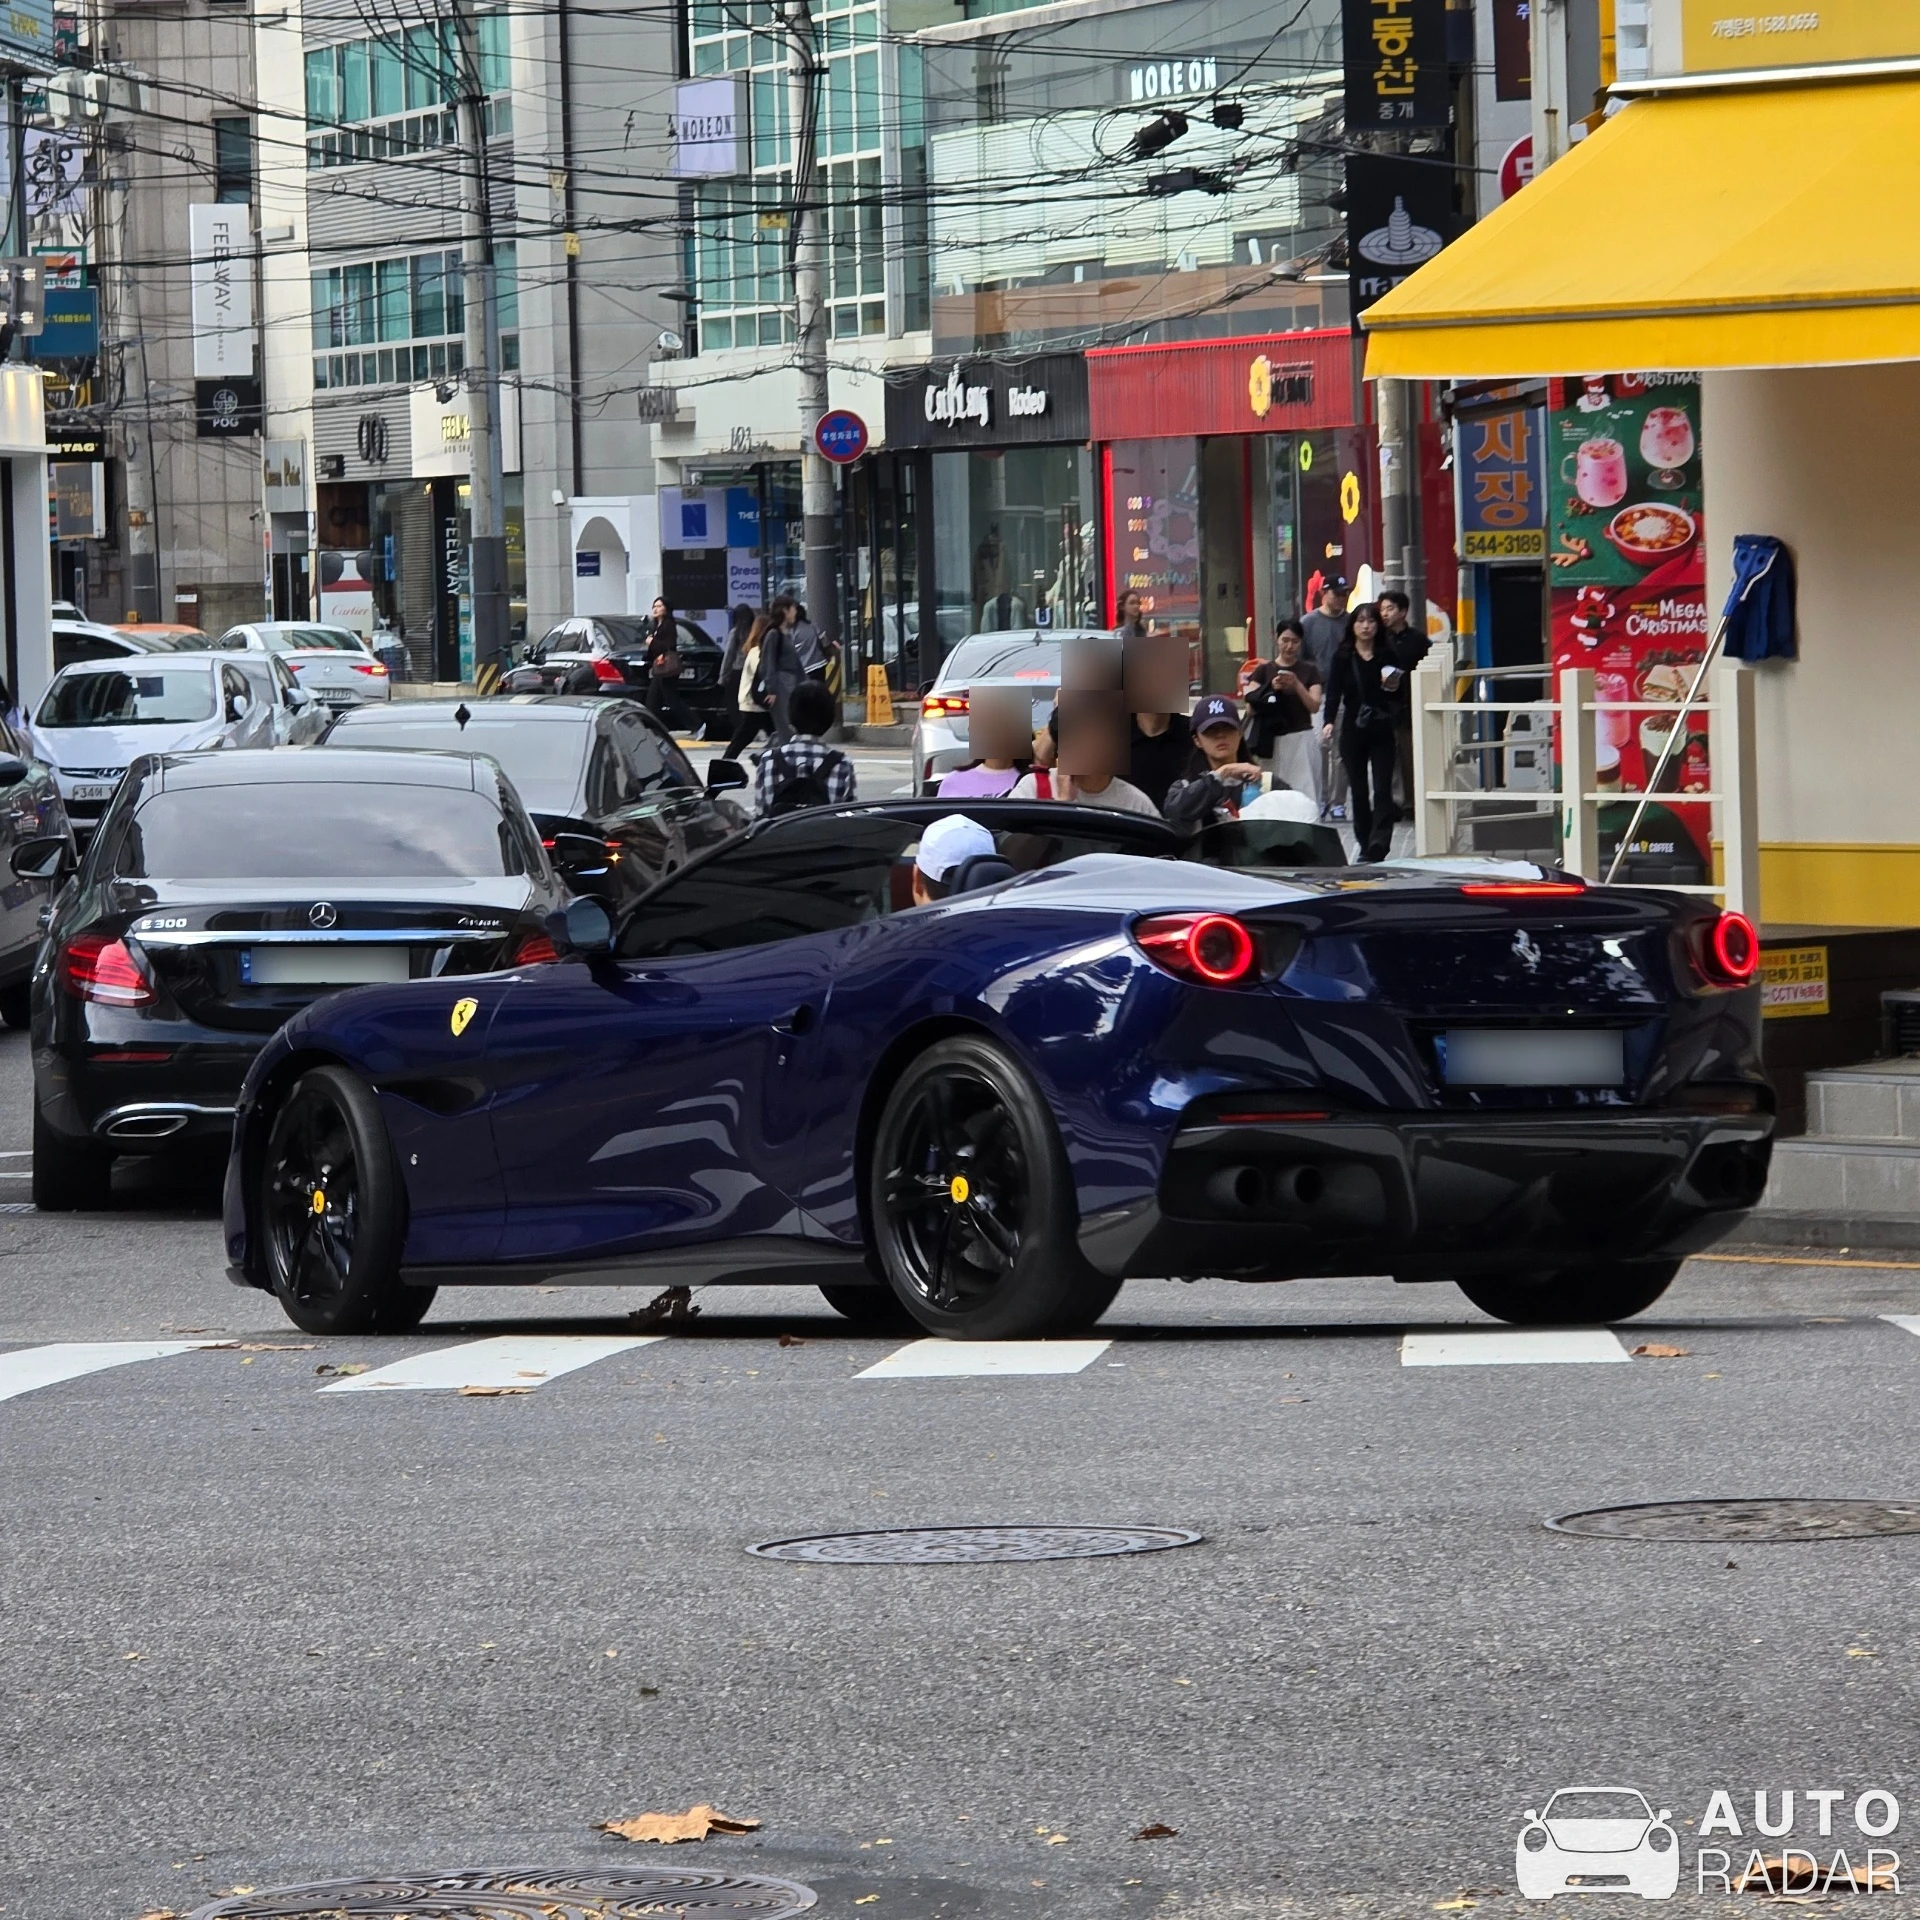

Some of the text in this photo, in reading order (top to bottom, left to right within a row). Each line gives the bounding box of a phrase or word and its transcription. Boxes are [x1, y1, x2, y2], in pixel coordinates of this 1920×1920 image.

[1130, 61, 1184, 101] MORE
[1378, 101, 1414, 119] 중개
[213, 222, 231, 311] FEELWAY
[1008, 385, 1046, 417] Rodeo
[212, 418, 239, 428] POG
[1464, 534, 1542, 555] 544-3189
[445, 516, 463, 596] FEELWAY
[730, 566, 760, 576] Drea
[1660, 599, 1706, 619] MEGA
[1625, 612, 1708, 637] CHRISTMAS
[153, 918, 187, 929] 300
